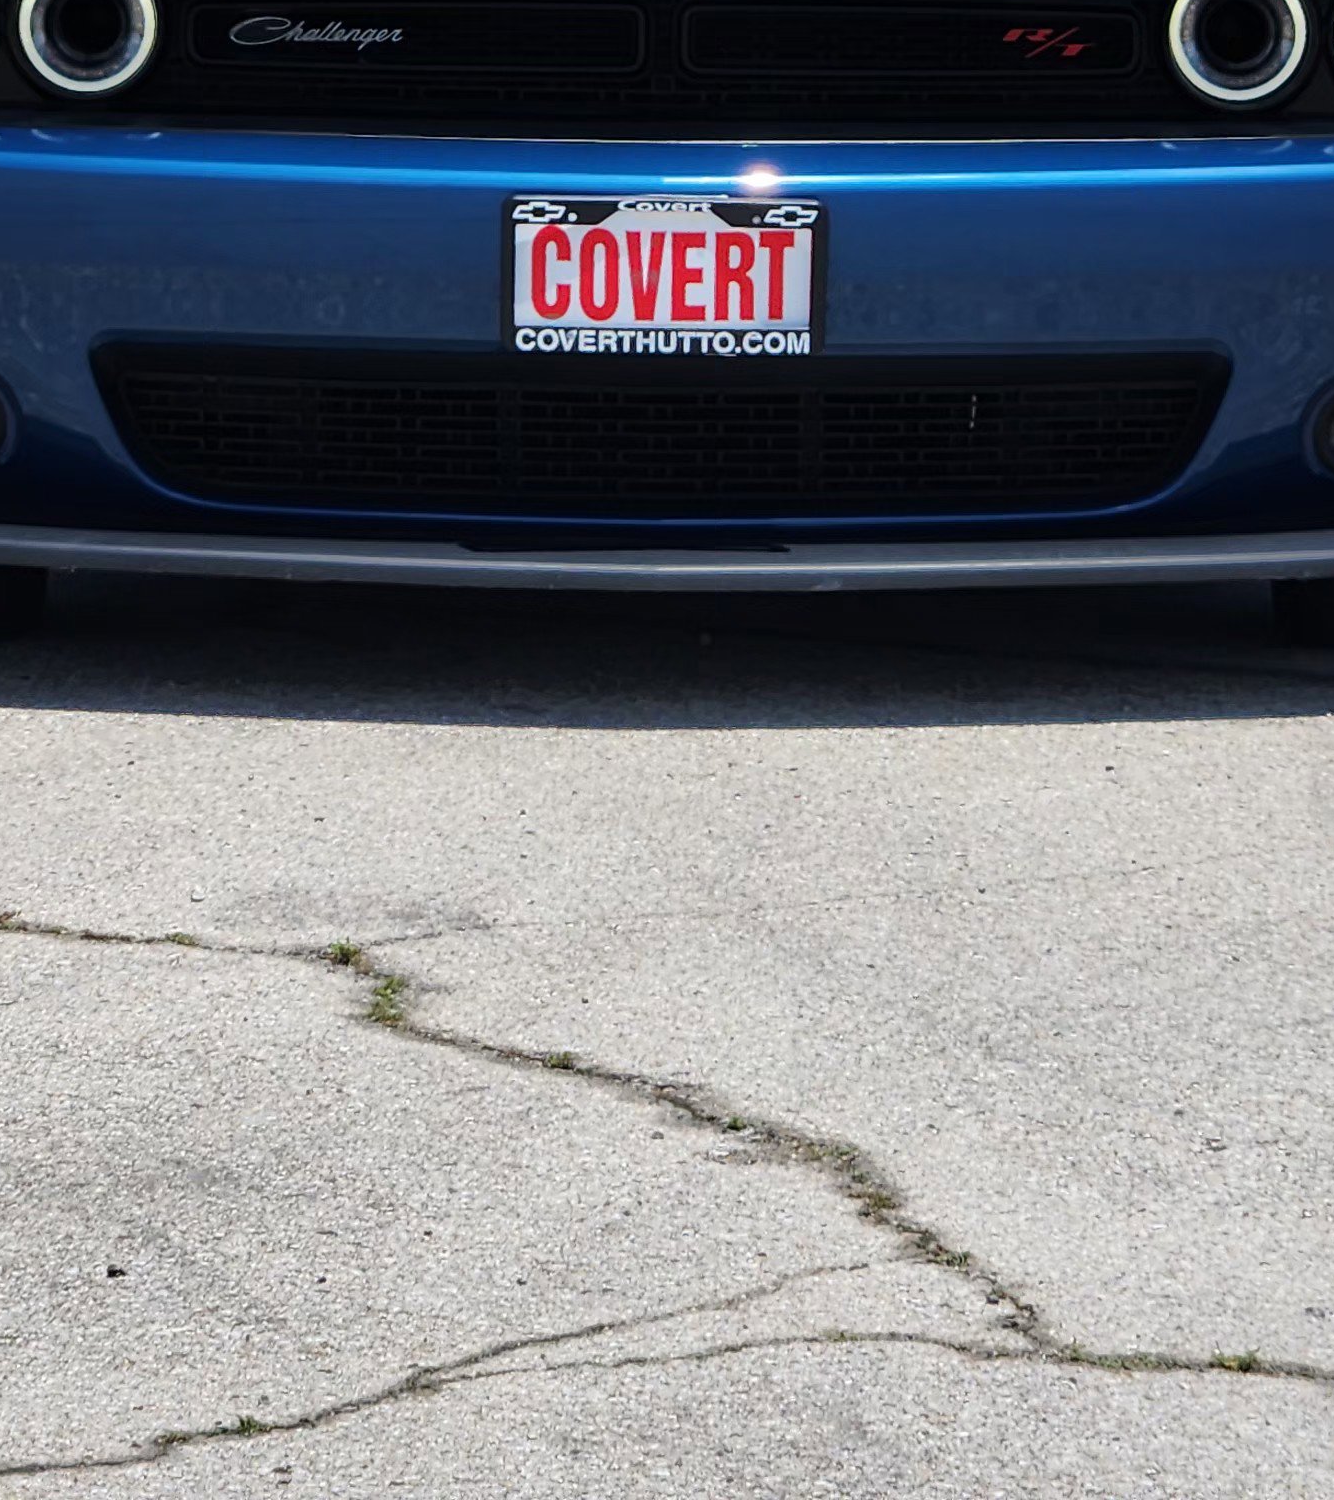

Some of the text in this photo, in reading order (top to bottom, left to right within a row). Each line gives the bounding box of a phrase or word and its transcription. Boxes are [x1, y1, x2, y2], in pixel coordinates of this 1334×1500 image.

[230, 16, 404, 51] Challenger
[1002, 26, 1096, 58] R/T
[617, 200, 712, 213] Covert
[531, 224, 795, 322] COVERT
[515, 326, 811, 356] COVERTHUTTO.COM
